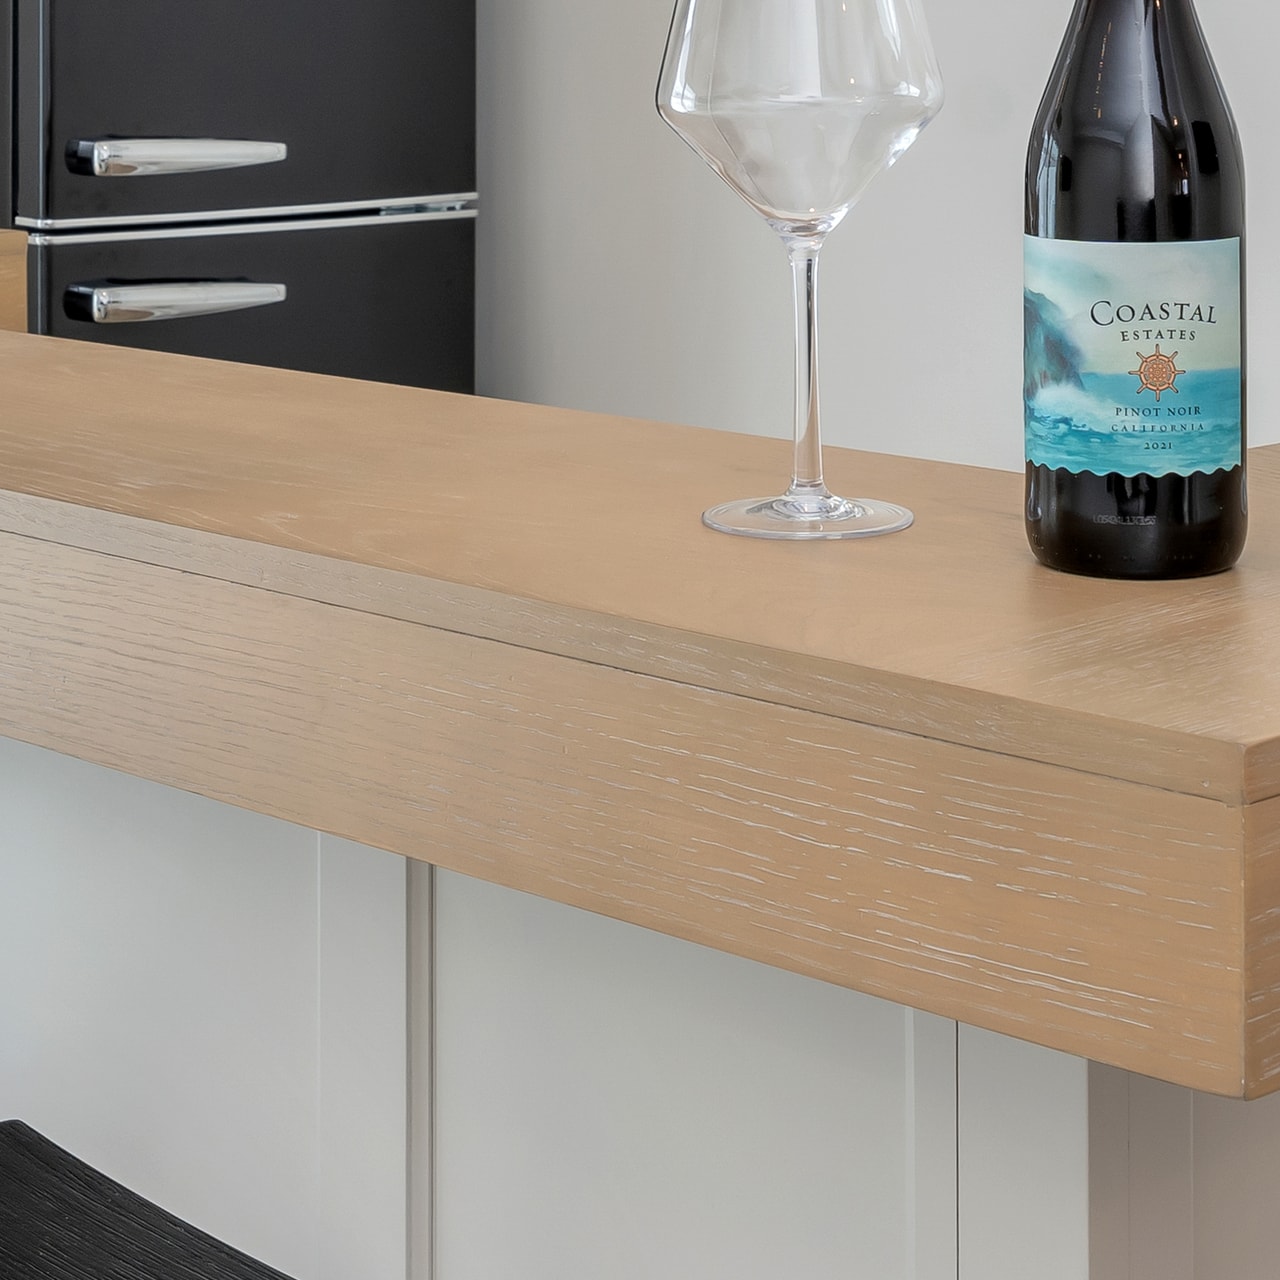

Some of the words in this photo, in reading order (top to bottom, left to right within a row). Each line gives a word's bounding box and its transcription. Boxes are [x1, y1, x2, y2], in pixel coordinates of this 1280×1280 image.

[1090, 300, 1218, 326] COASTAL
[1121, 329, 1196, 342] ESTATES
[1115, 407, 1160, 417] PINOT
[1167, 405, 1201, 416] NOIR
[1111, 423, 1204, 432] CALIFORNIA
[1144, 442, 1173, 450] 2021
